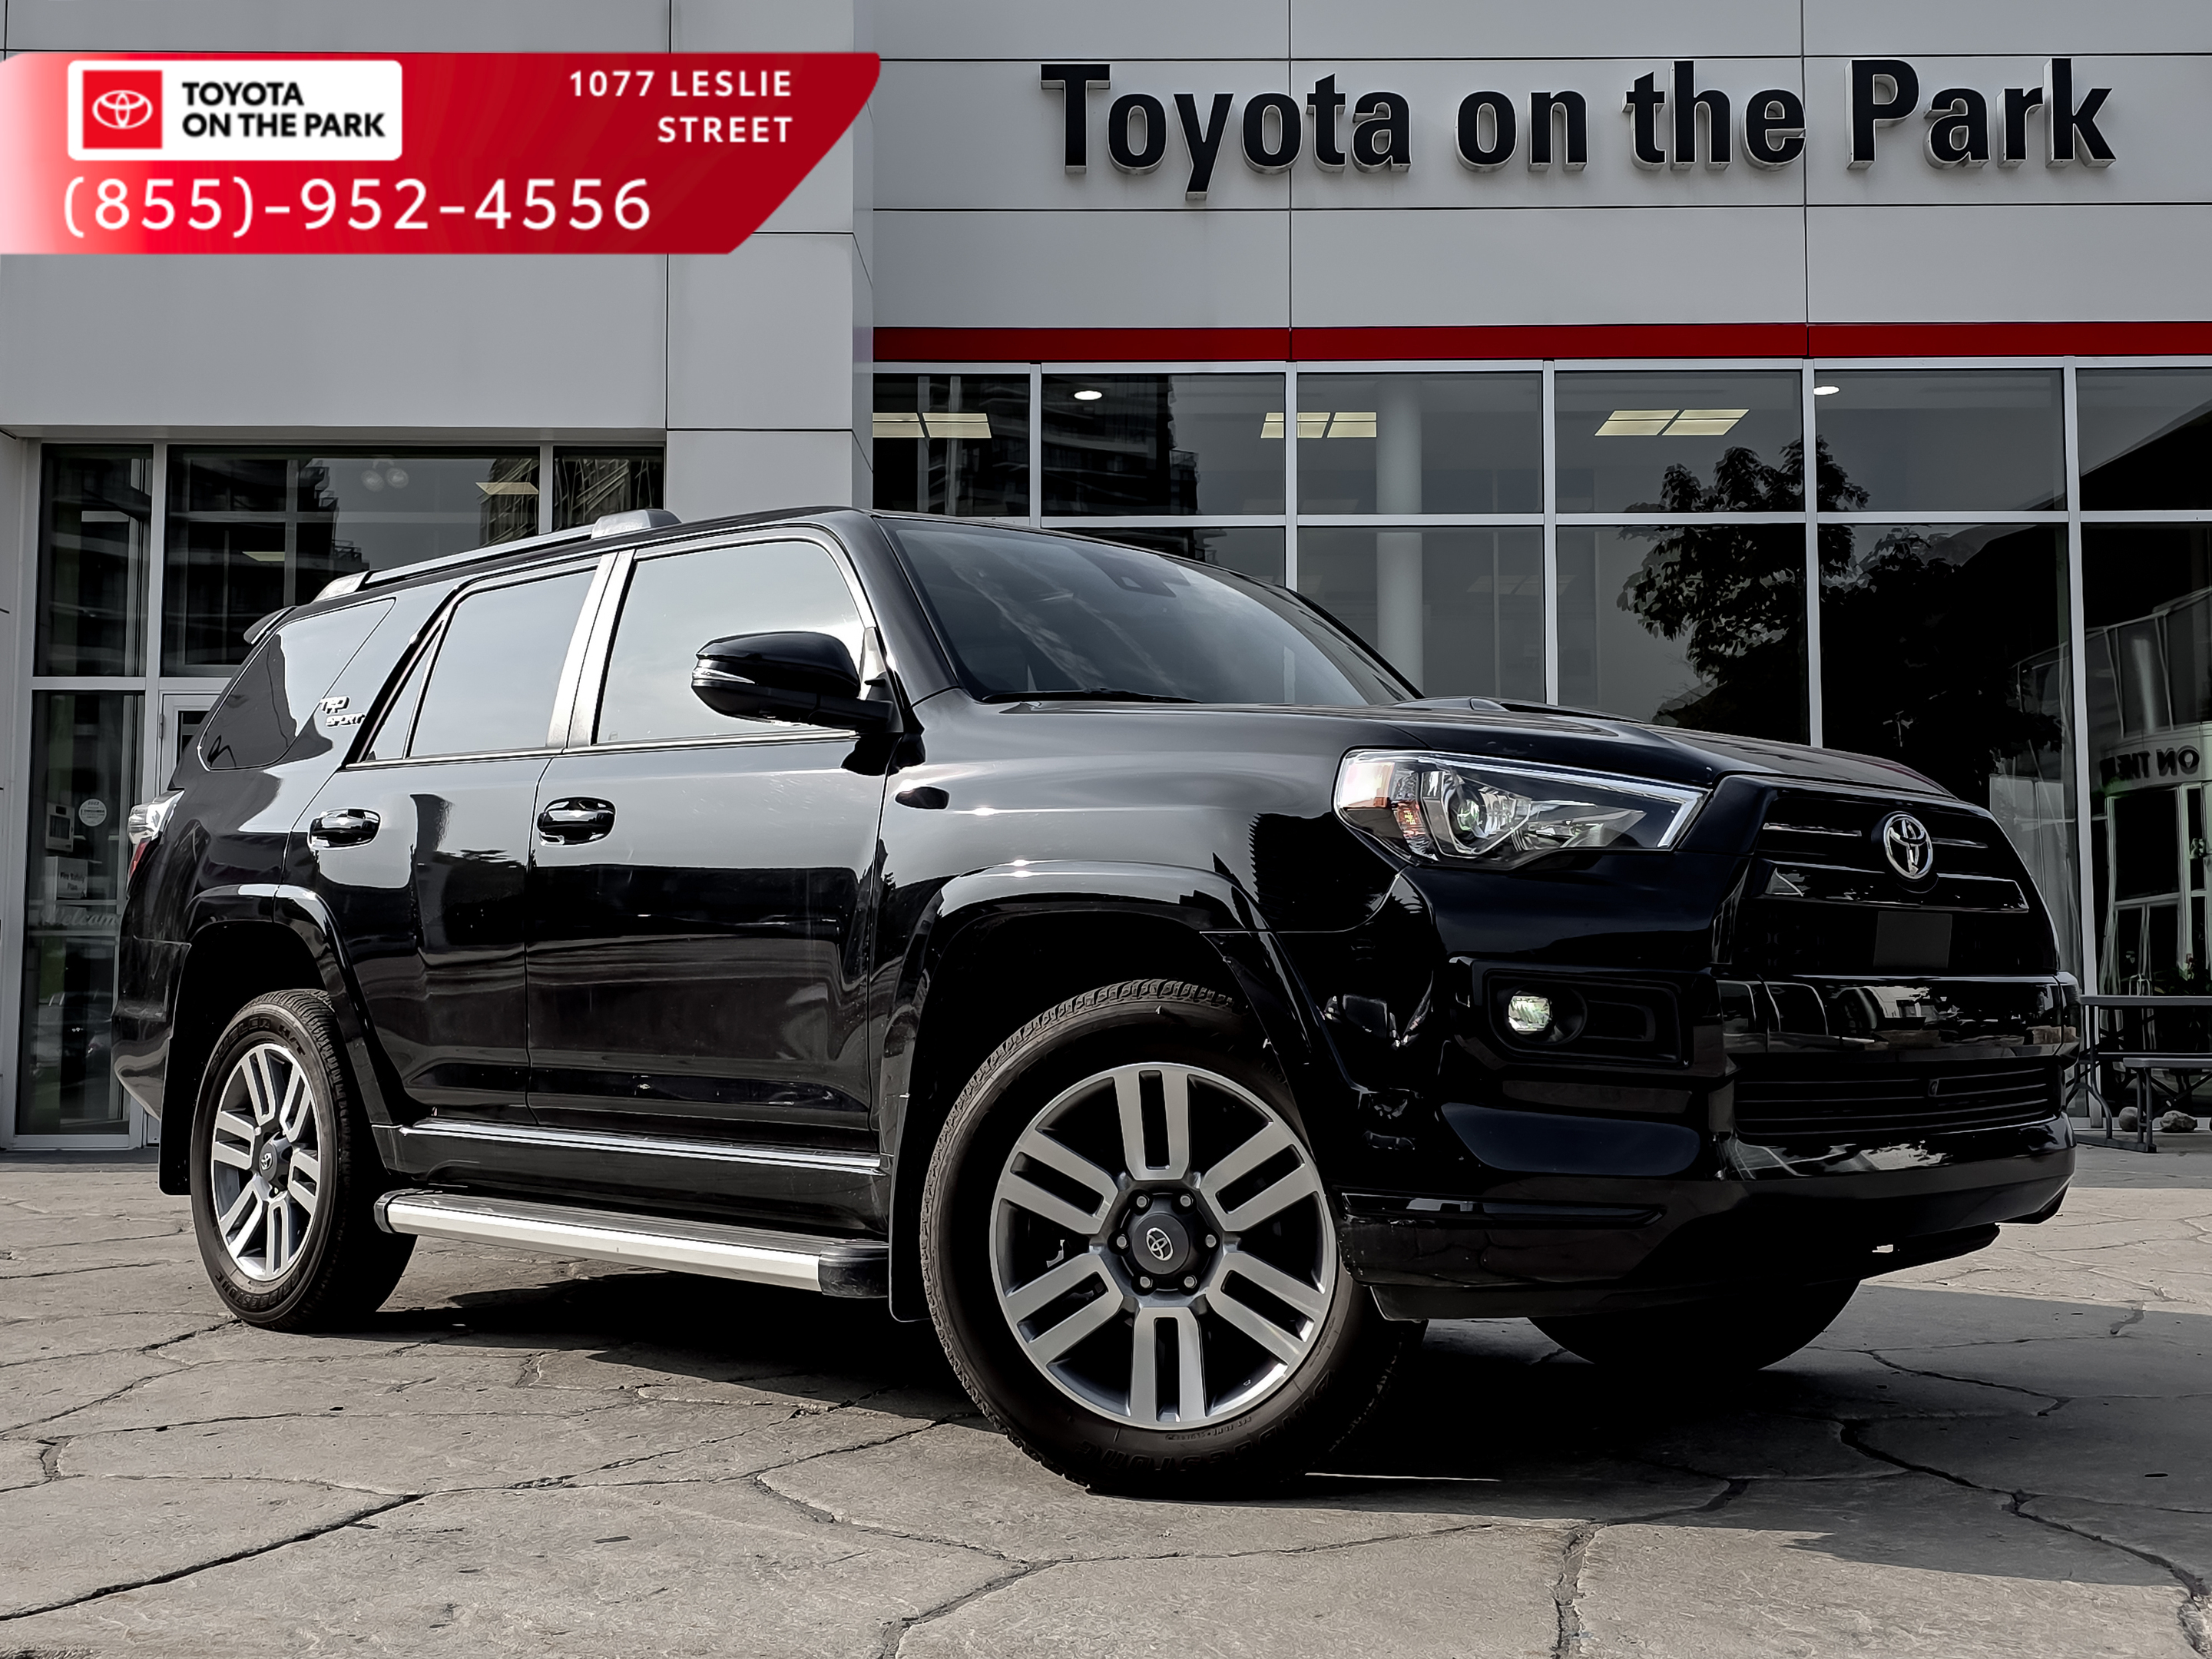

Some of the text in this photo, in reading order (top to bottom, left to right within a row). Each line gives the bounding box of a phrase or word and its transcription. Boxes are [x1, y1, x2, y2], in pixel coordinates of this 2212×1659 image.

[1040, 58, 2117, 200] Toyota on the Park
[320, 696, 350, 714] TRD
